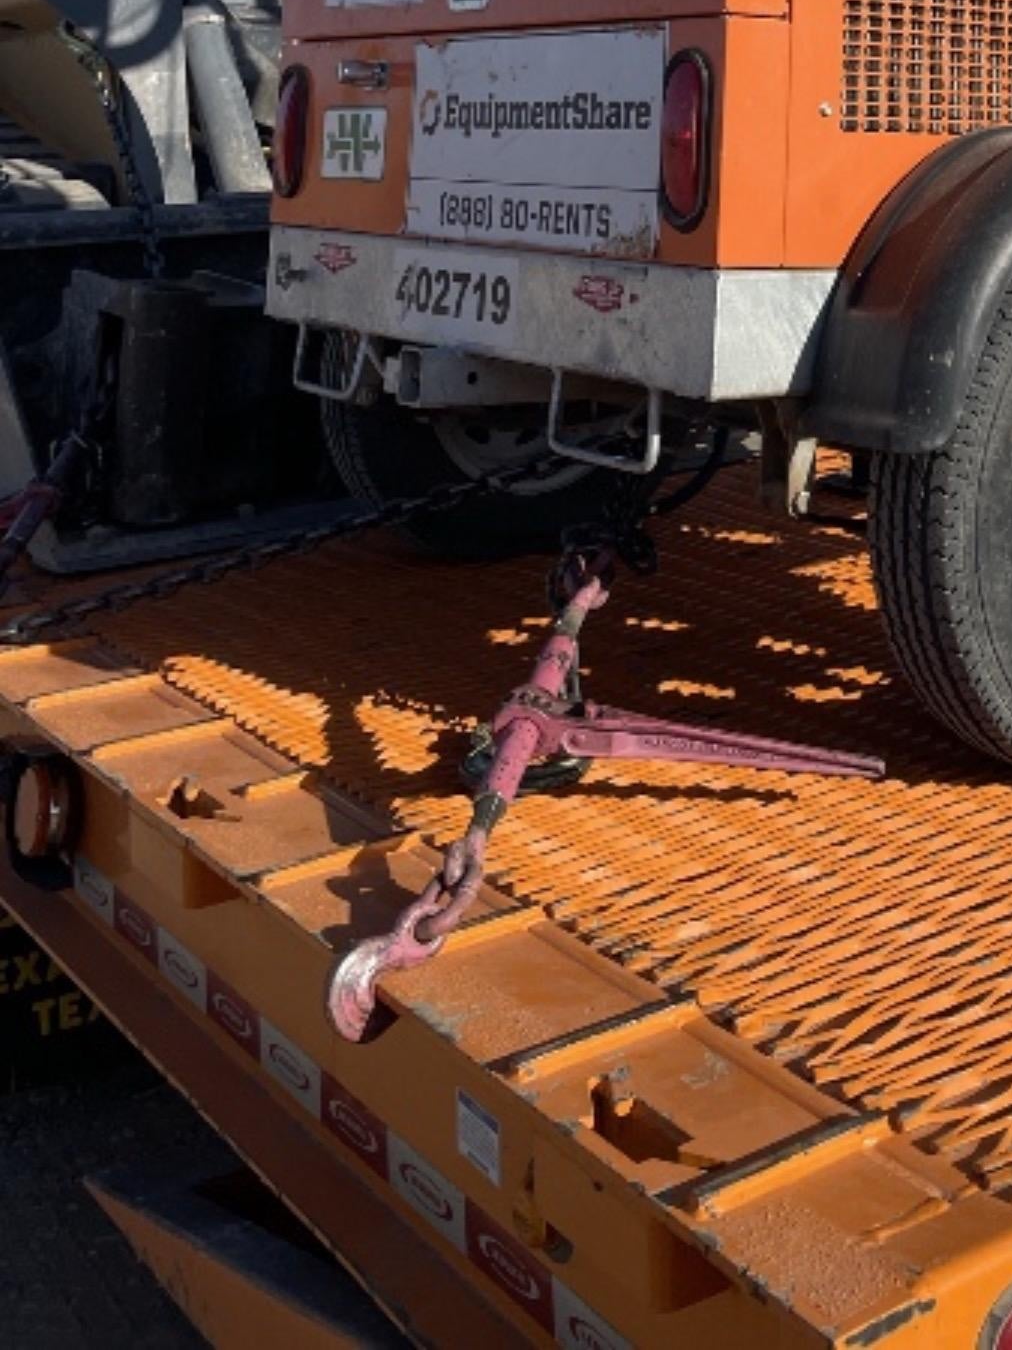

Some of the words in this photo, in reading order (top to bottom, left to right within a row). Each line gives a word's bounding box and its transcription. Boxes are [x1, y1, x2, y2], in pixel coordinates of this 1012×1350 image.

[444, 92, 652, 138] EquipmentShare
[439, 191, 494, 232] (888)
[500, 197, 612, 238] 80-RENTS
